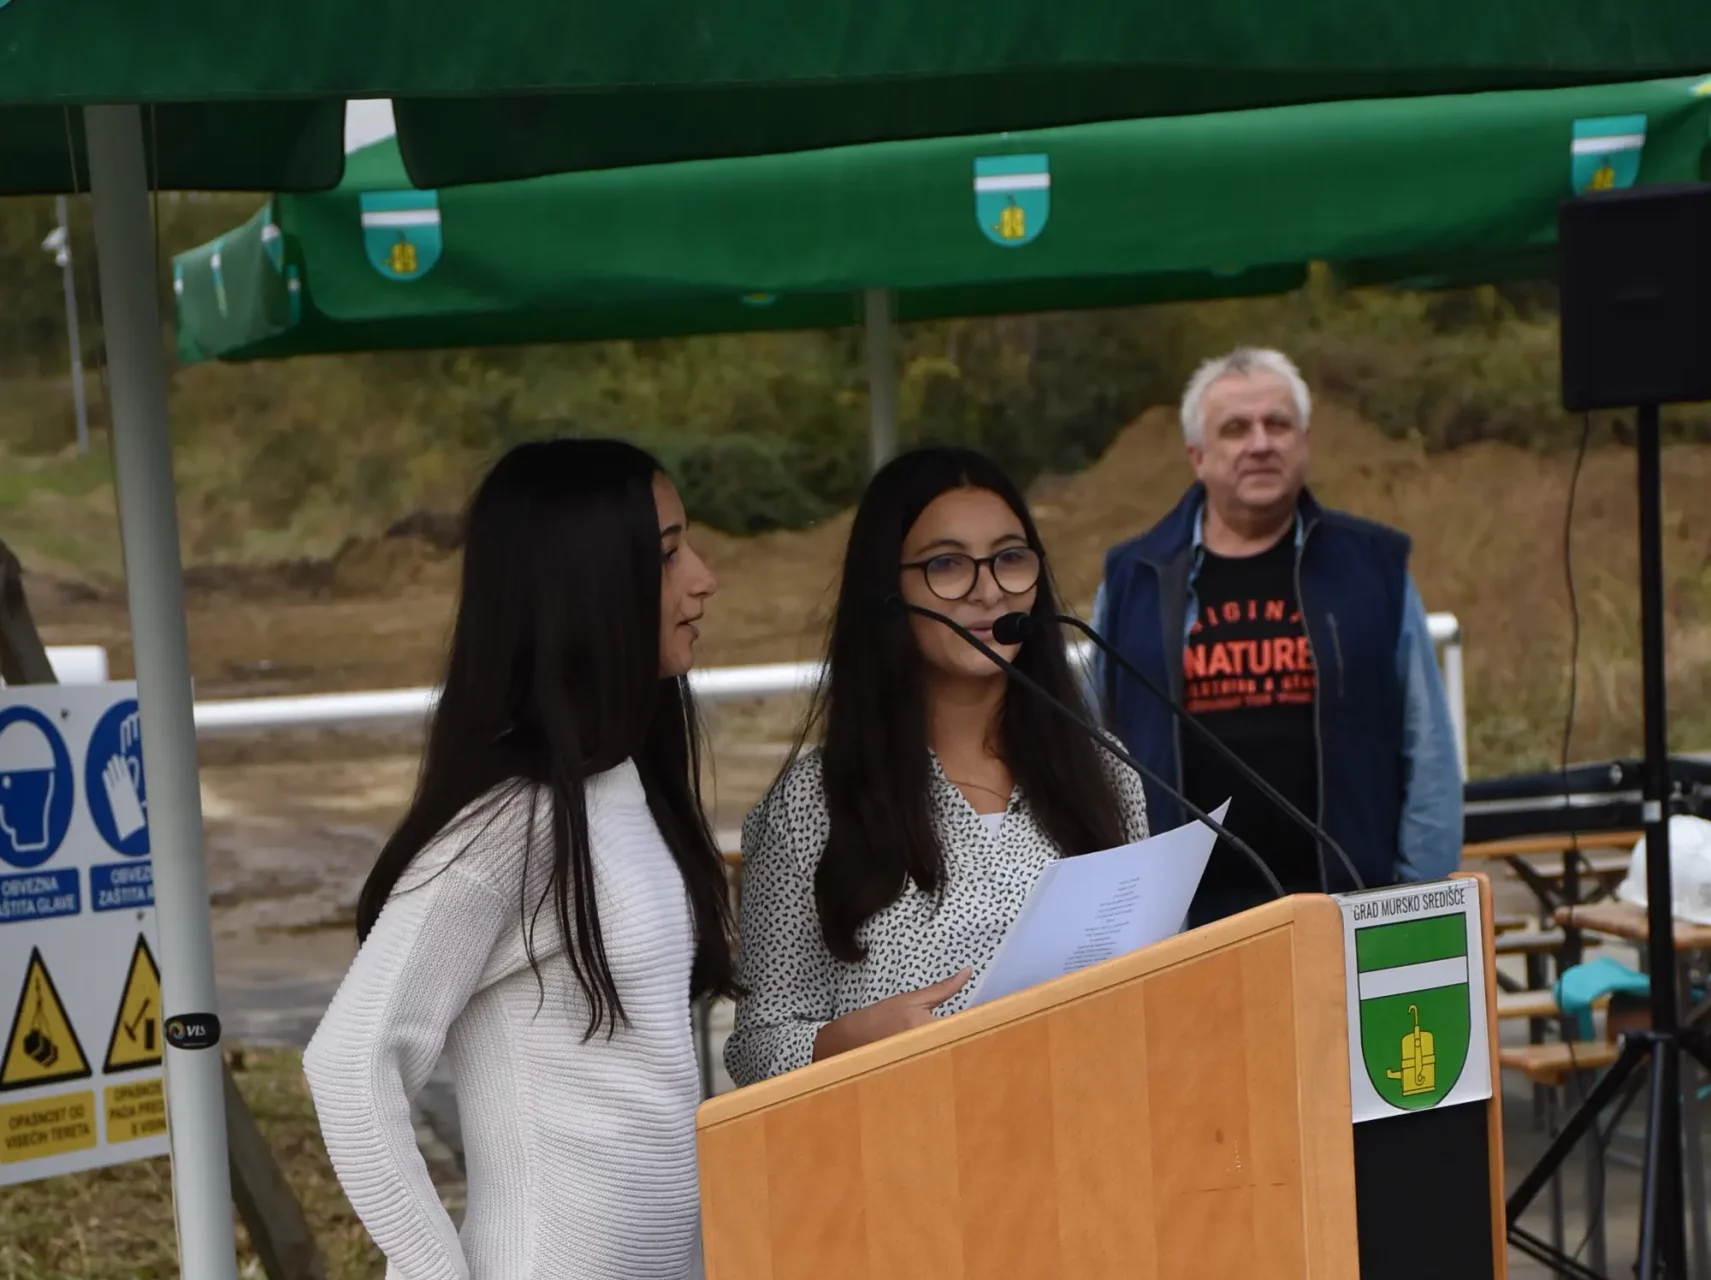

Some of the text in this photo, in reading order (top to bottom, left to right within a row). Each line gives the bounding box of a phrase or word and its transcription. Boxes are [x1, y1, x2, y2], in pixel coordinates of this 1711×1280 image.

[1184, 636, 1313, 679] NATURE
[1, 875, 60, 897] OBVEZNA
[99, 885, 145, 907] ZAŠTITA
[37, 894, 76, 914] GLAVE
[1353, 883, 1466, 921] GRAD MURSKO SREDIŠĆE
